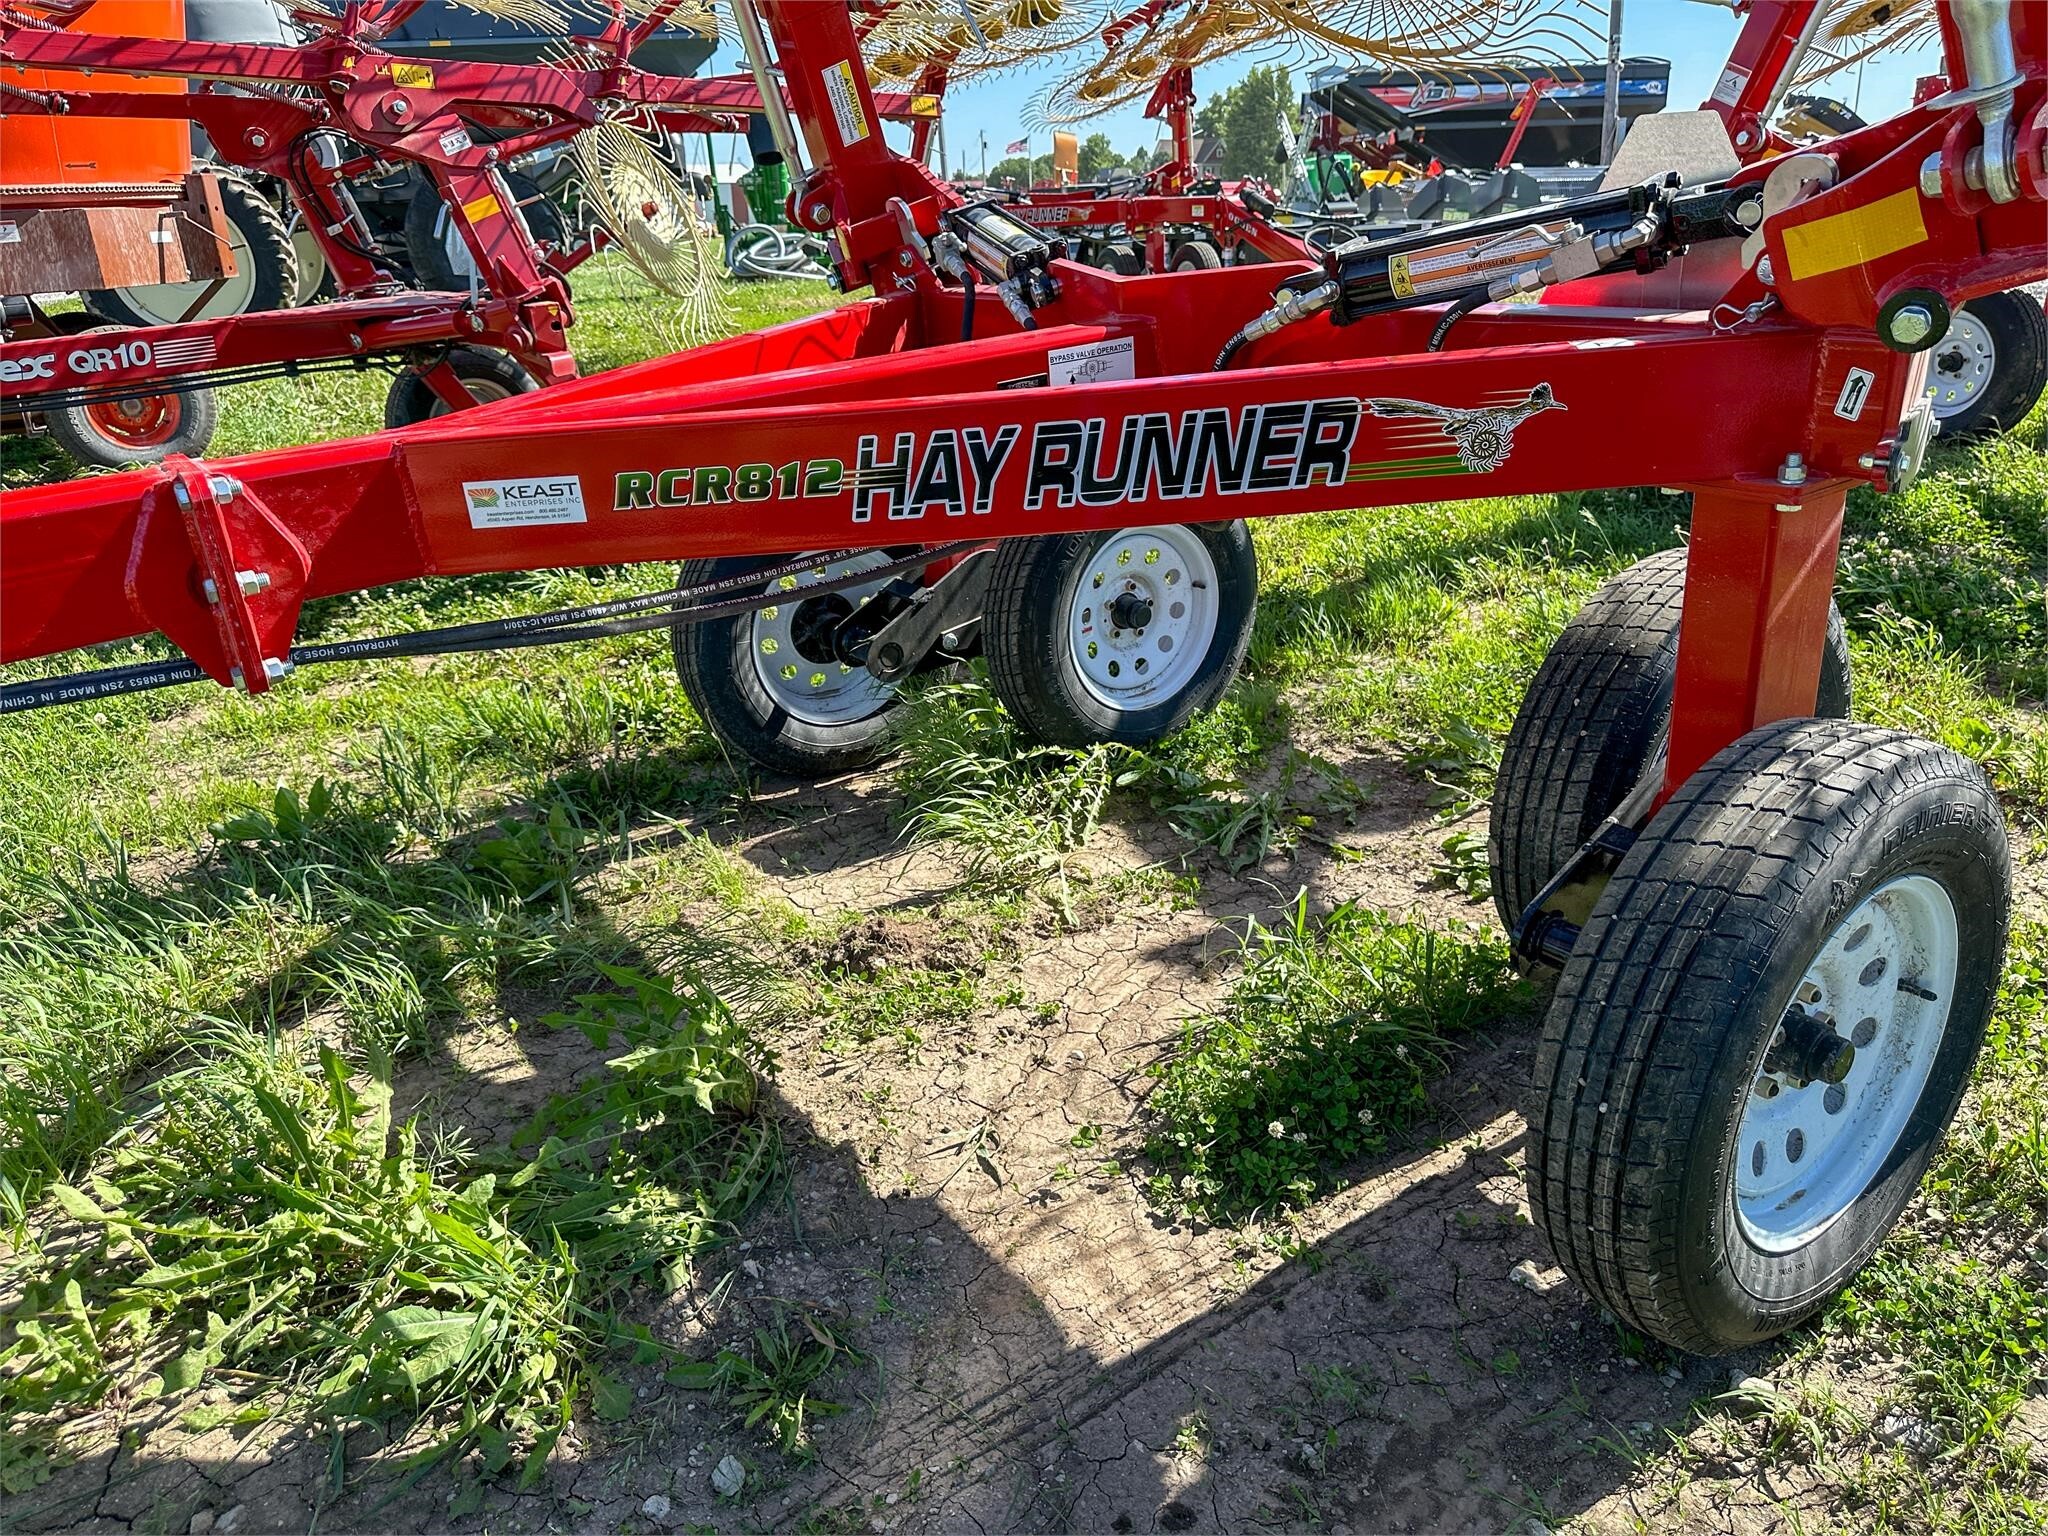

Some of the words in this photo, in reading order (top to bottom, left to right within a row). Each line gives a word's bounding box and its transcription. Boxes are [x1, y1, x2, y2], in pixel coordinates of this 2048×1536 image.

[841, 88, 850, 108] CLEAR
[847, 107, 854, 117] OF
[846, 86, 863, 124] CAUTION
[834, 97, 846, 129] OPERATING
[842, 110, 855, 140] LOWERING
[1027, 207, 1070, 223] RUNNER
[1466, 256, 1517, 272] AVERTISSEMENT
[68, 341, 151, 374] QR10
[1050, 353, 1075, 364] BYPASS
[1076, 348, 1096, 358] VALVE
[1096, 342, 1132, 355] OPERATION
[613, 457, 844, 511] RCR812
[852, 425, 1022, 523] HAY
[1024, 397, 1362, 510] RUNNER
[502, 482, 577, 500] KEAST
[505, 499, 563, 508] ENTERPRISES
[566, 496, 581, 504] INC
[814, 554, 831, 564] SAE
[719, 580, 735, 589] 2SN
[737, 573, 762, 585] EN853
[680, 589, 691, 598] IN
[692, 583, 717, 595] MADE
[631, 598, 649, 609] MAX
[650, 593, 678, 605] CHINA
[587, 606, 608, 617] 4800
[610, 602, 628, 613] W/P
[540, 613, 568, 625] MSHA
[571, 609, 586, 619] PSI
[503, 617, 540, 631] IC-330/1
[304, 647, 335, 659] HOSE
[339, 639, 399, 655] HYDRAULIC
[101, 680, 125, 692] 2SN
[129, 672, 166, 688] EN853
[40, 691, 54, 702] IN
[59, 685, 96, 699] MADE
